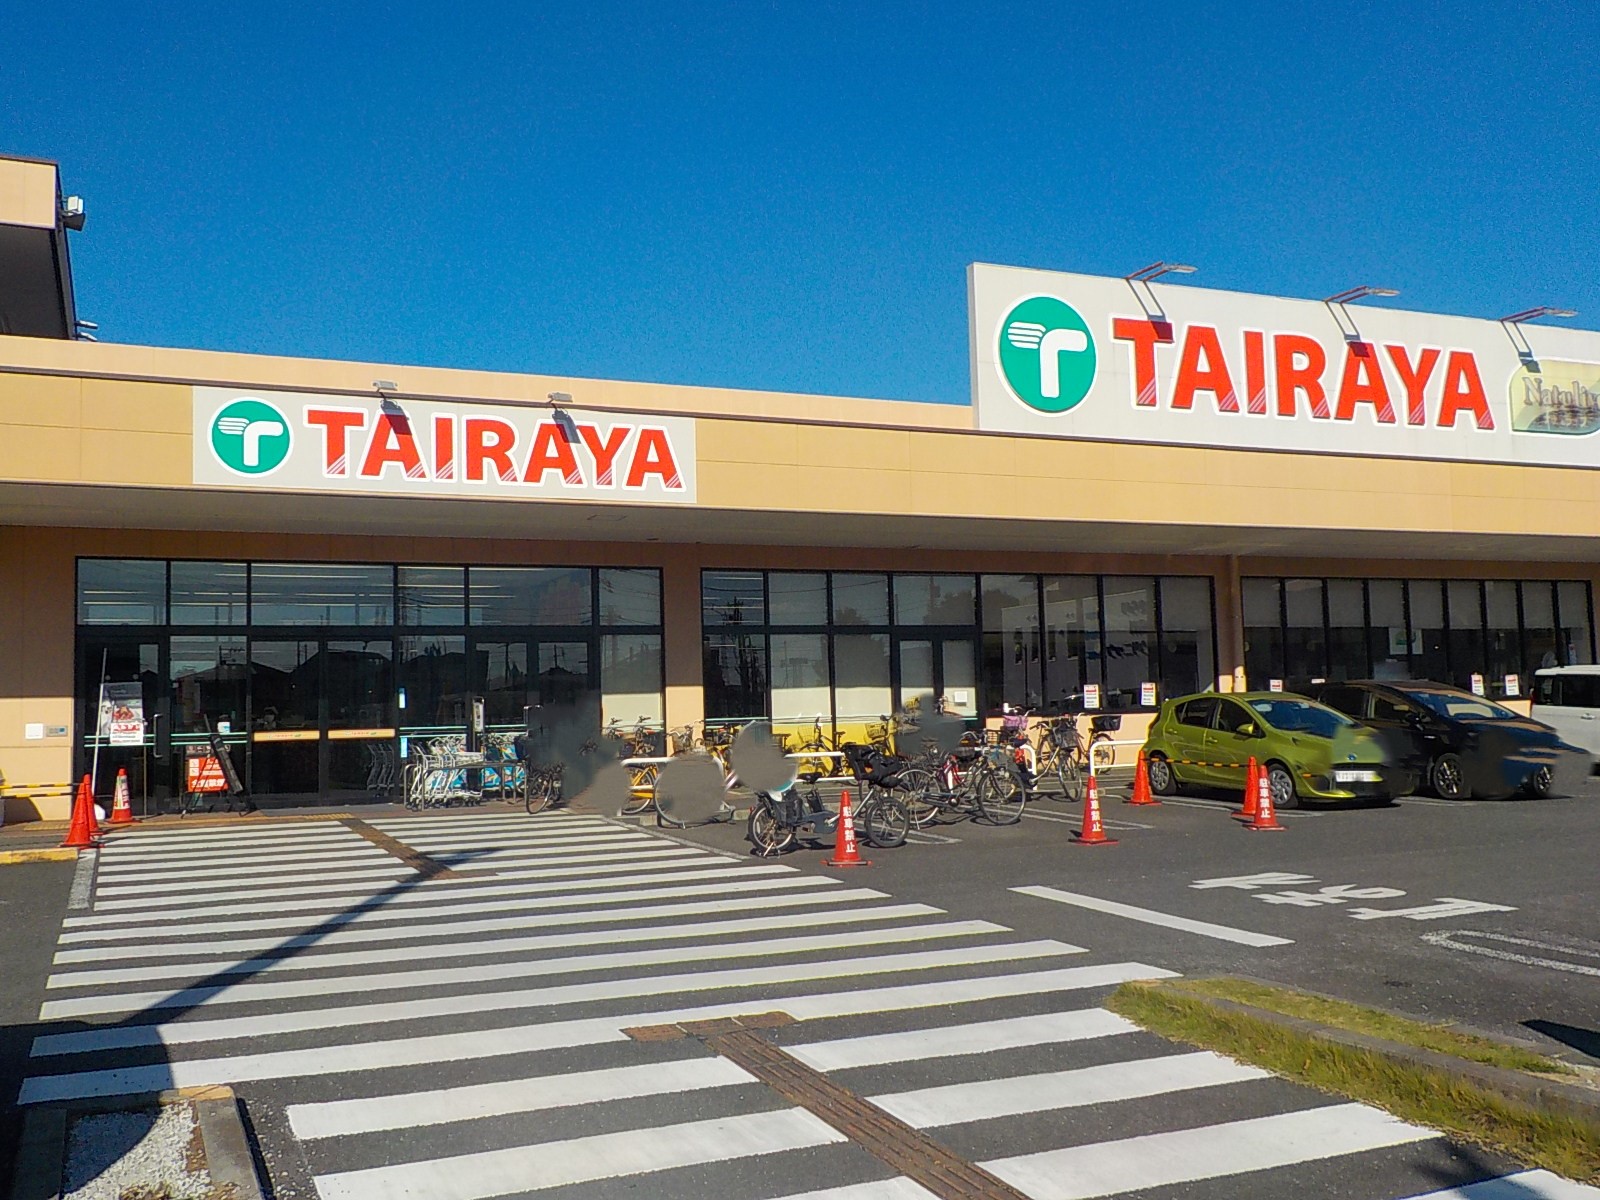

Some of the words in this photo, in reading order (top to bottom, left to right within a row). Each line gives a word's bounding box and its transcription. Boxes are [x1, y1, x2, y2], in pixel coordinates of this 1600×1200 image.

[1112, 317, 1495, 429] TAIRAYA
[1522, 377, 1600, 408] Natuliv
[306, 409, 683, 489] TAIRAYA
[1089, 789, 1101, 832] 駐車禁止
[1259, 778, 1271, 818] 駐車禁止
[842, 806, 856, 853] 駐車禁止
